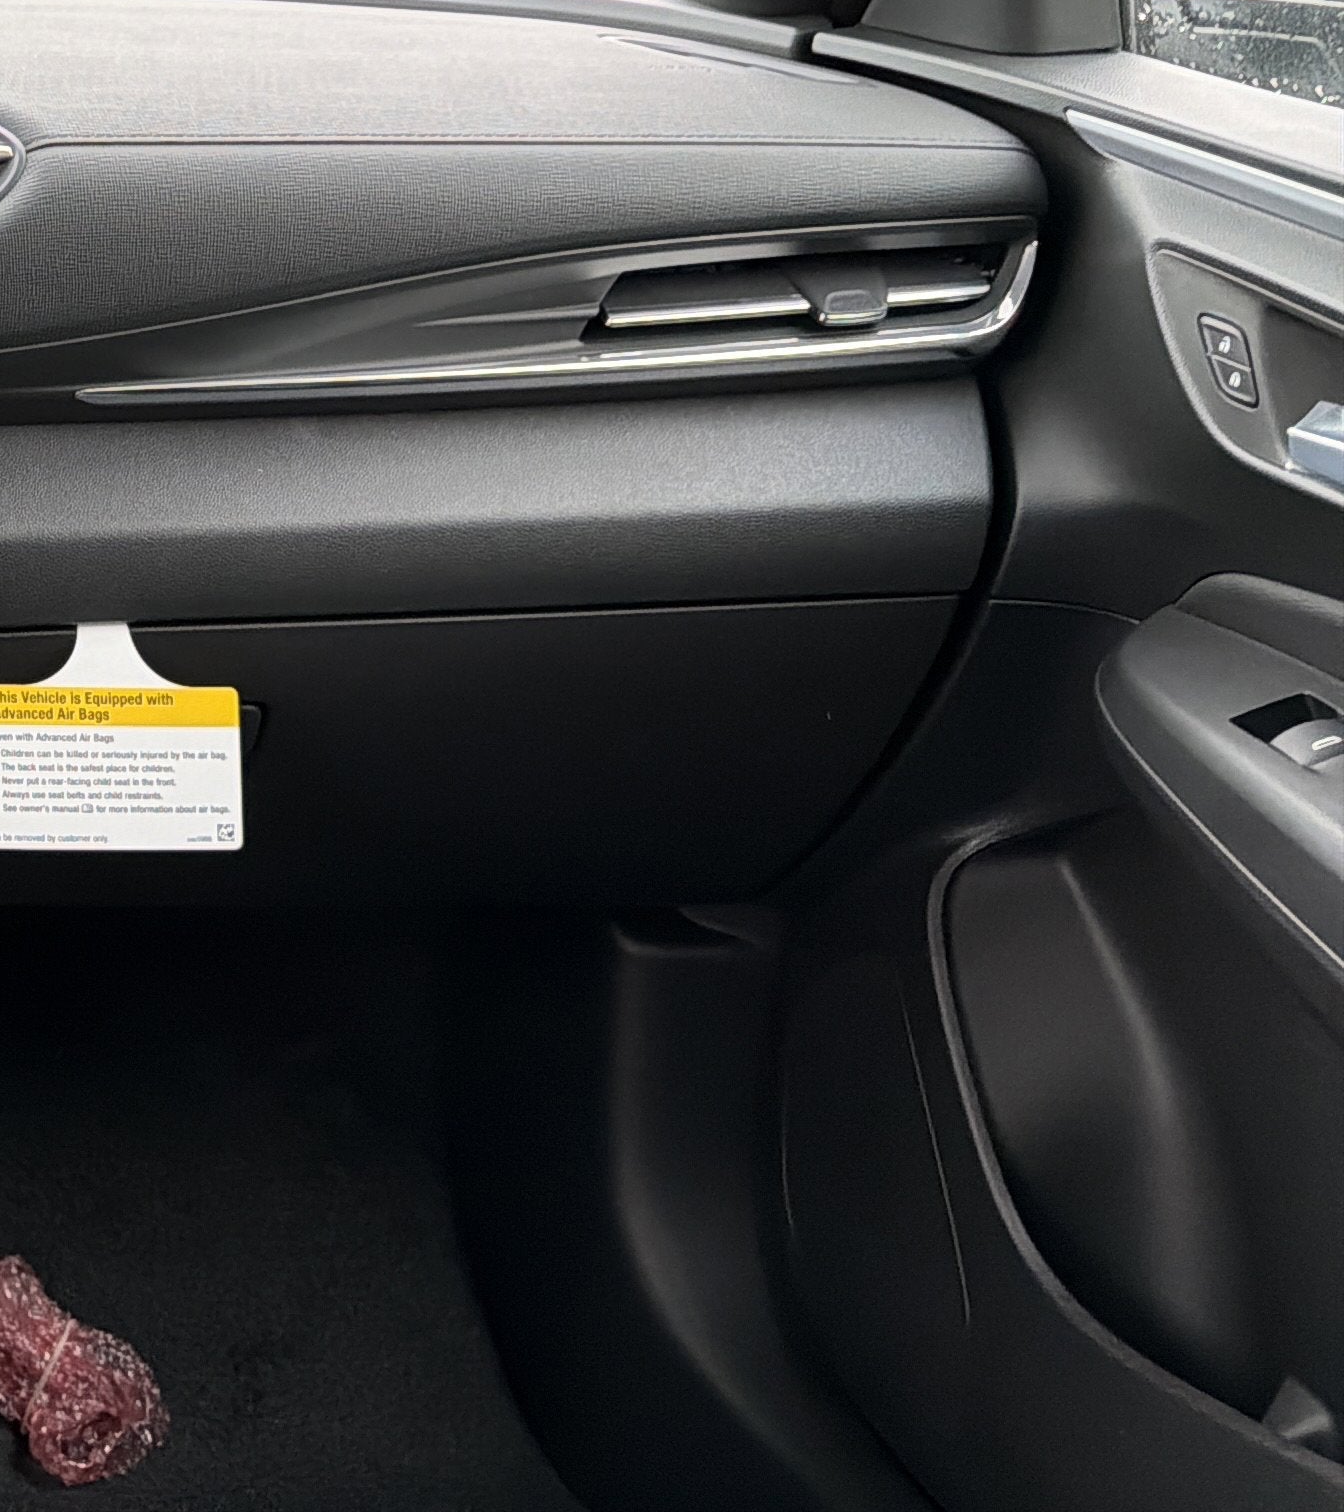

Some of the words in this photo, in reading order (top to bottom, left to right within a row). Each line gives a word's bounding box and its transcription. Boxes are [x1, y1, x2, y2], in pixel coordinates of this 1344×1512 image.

[21, 690, 67, 704] Vehicle
[85, 692, 142, 708] Equipped
[146, 693, 173, 705] with
[57, 707, 74, 720] Air
[78, 708, 109, 723] Bags
[15, 732, 33, 741] with
[36, 732, 77, 742] Advanced
[79, 732, 90, 742] Air
[93, 733, 114, 744] Bags
[0, 748, 34, 758] Children
[54, 750, 63, 758] be
[66, 750, 88, 758] killed
[101, 751, 137, 760] seriously
[140, 751, 168, 760] injured
[170, 751, 180, 760] by
[182, 751, 195, 759] the
[210, 751, 227, 761] bag.
[1, 762, 15, 771] The
[18, 763, 36, 771] back
[66, 764, 78, 772] the
[80, 764, 104, 772] safest
[106, 764, 126, 773] place
[129, 764, 139, 772] for
[141, 764, 175, 773] children.
[2, 776, 24, 785] Never
[26, 777, 39, 786] put
[48, 777, 91, 787] rear-facing
[93, 777, 111, 786] child
[114, 778, 130, 786] seat
[132, 778, 139, 786] in
[141, 778, 153, 786] the
[156, 777, 176, 786] front.
[2, 790, 30, 800] Always
[48, 791, 64, 799] seat
[66, 791, 85, 799] belts
[88, 791, 102, 799] and
[104, 791, 122, 799] child
[125, 792, 163, 800] restraints.
[3, 803, 17, 812] See
[19, 804, 49, 813] owner's
[52, 804, 79, 813] manual
[96, 805, 106, 813] for
[130, 805, 173, 814] information
[175, 805, 196, 814] about
[198, 805, 208, 814] air
[210, 805, 230, 815] bags.
[3, 833, 12, 841] be
[14, 834, 45, 842] removed
[47, 834, 55, 843] by
[58, 834, 90, 842] customer
